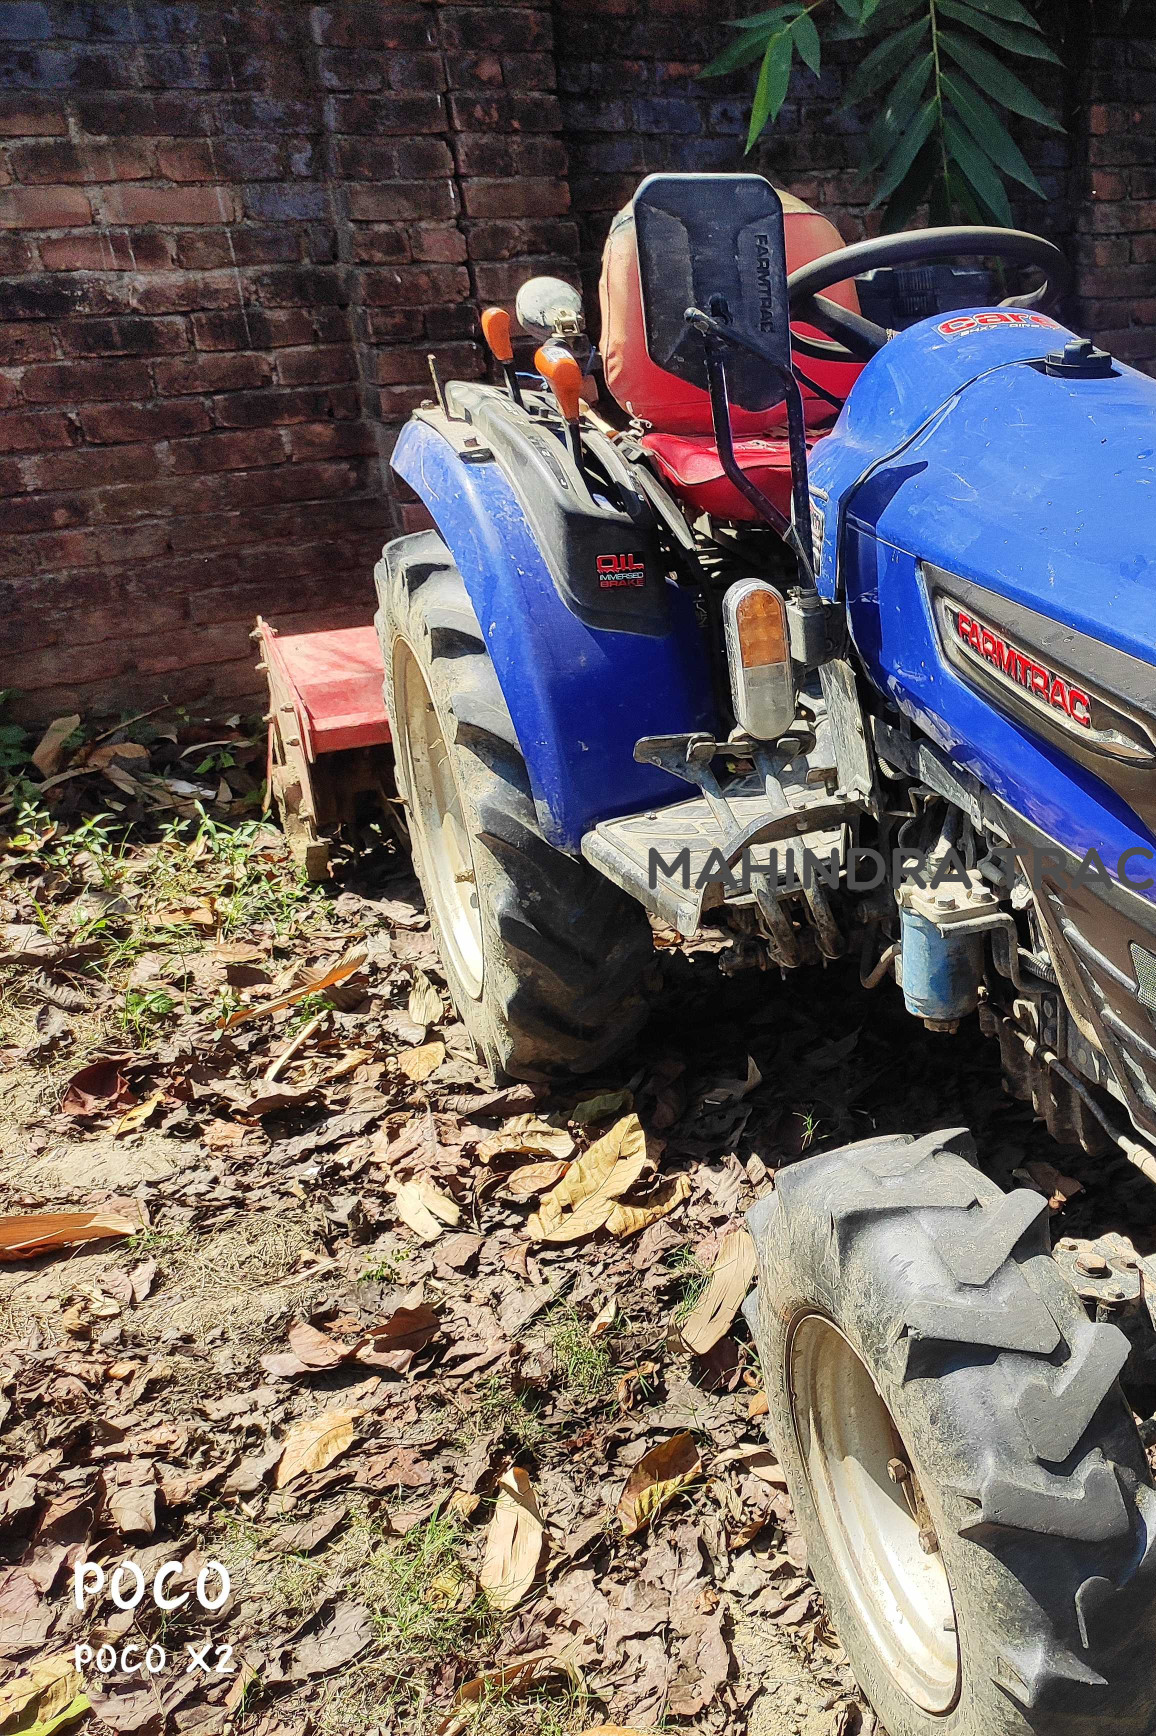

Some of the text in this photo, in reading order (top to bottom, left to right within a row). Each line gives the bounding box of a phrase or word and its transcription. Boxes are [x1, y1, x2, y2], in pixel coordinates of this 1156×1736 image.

[755, 234, 774, 333] FARMTRAC
[596, 553, 645, 573] OIL
[600, 572, 644, 580] IMMERSED
[600, 579, 645, 588] BRAKE
[957, 611, 1091, 729] FARMTRAC
